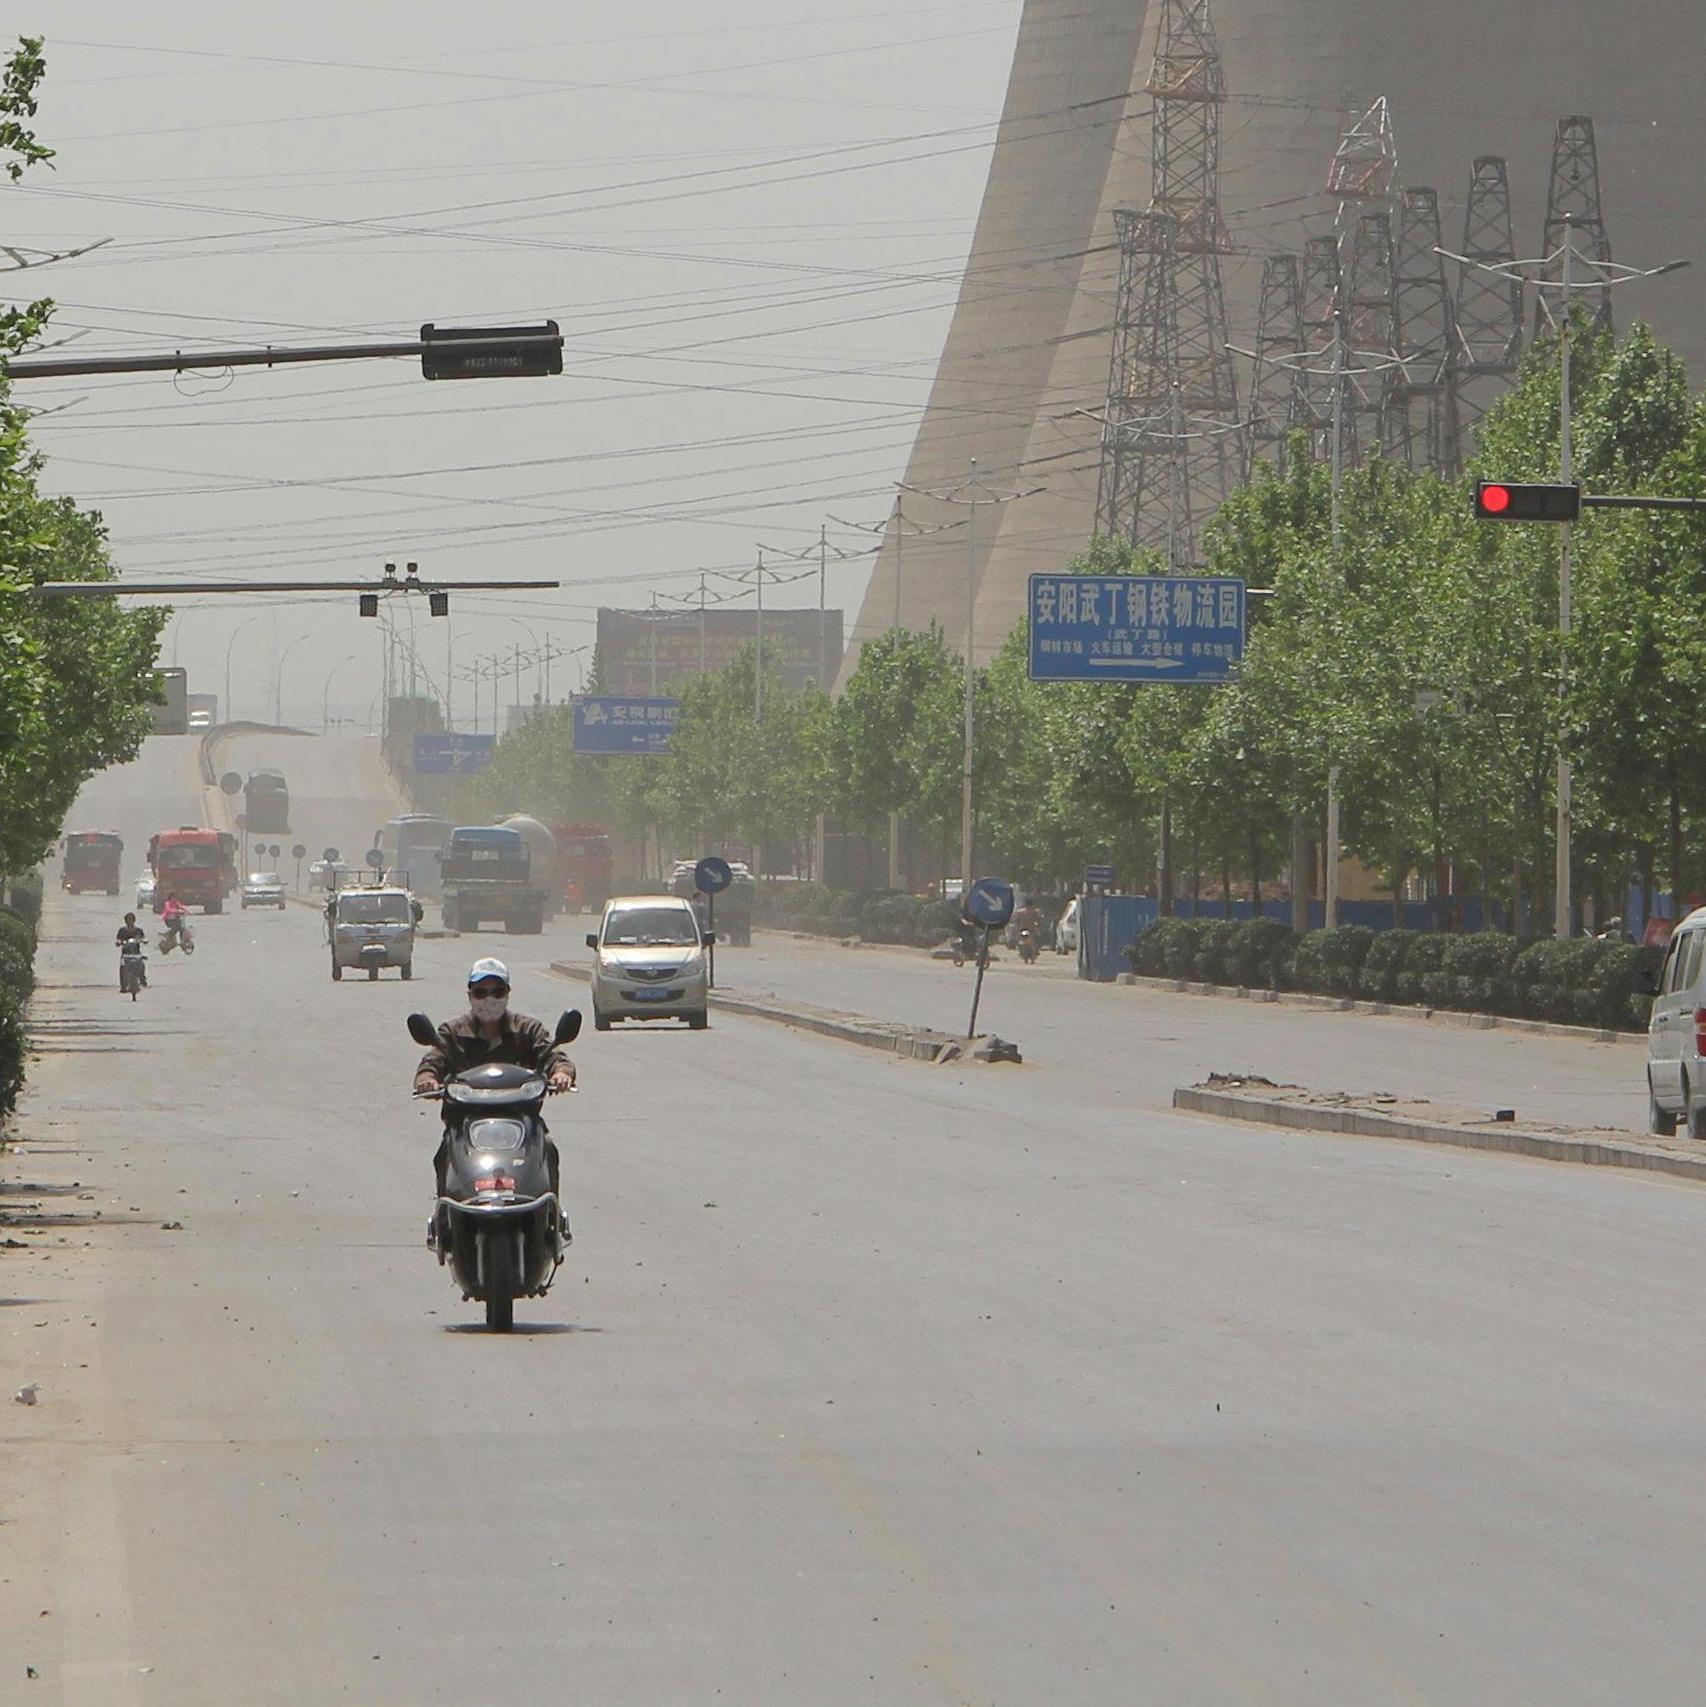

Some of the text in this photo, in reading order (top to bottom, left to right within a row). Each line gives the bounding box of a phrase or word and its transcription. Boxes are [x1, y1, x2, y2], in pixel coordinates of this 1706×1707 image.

[1036, 580, 1238, 629] 安阳武丁钢铁物流园
